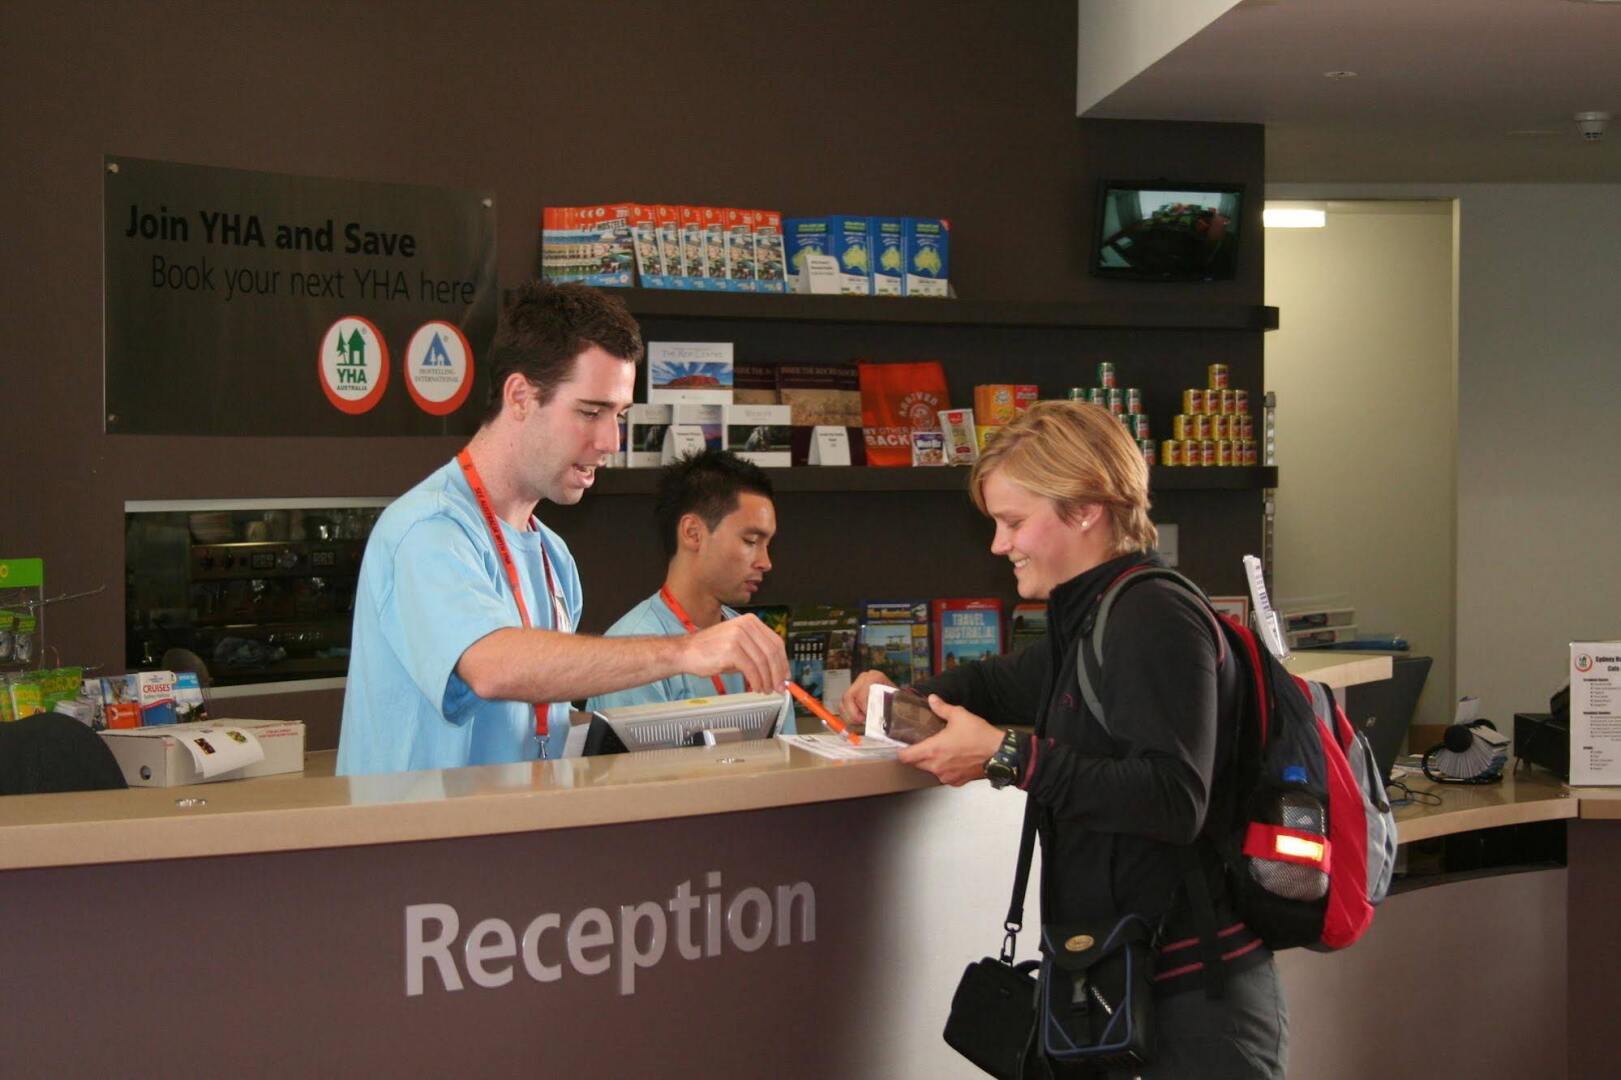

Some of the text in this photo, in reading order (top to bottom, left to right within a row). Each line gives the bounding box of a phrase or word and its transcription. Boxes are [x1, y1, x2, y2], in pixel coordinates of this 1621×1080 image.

[125, 205, 416, 257] Join YHA and Save
[151, 255, 475, 305] Book your next YHA here
[336, 368, 367, 384] YHA
[898, 391, 939, 417] ARRIVED
[952, 613, 985, 626] TRAVEL
[143, 683, 171, 693] CRUISES
[404, 870, 817, 997] Reception
